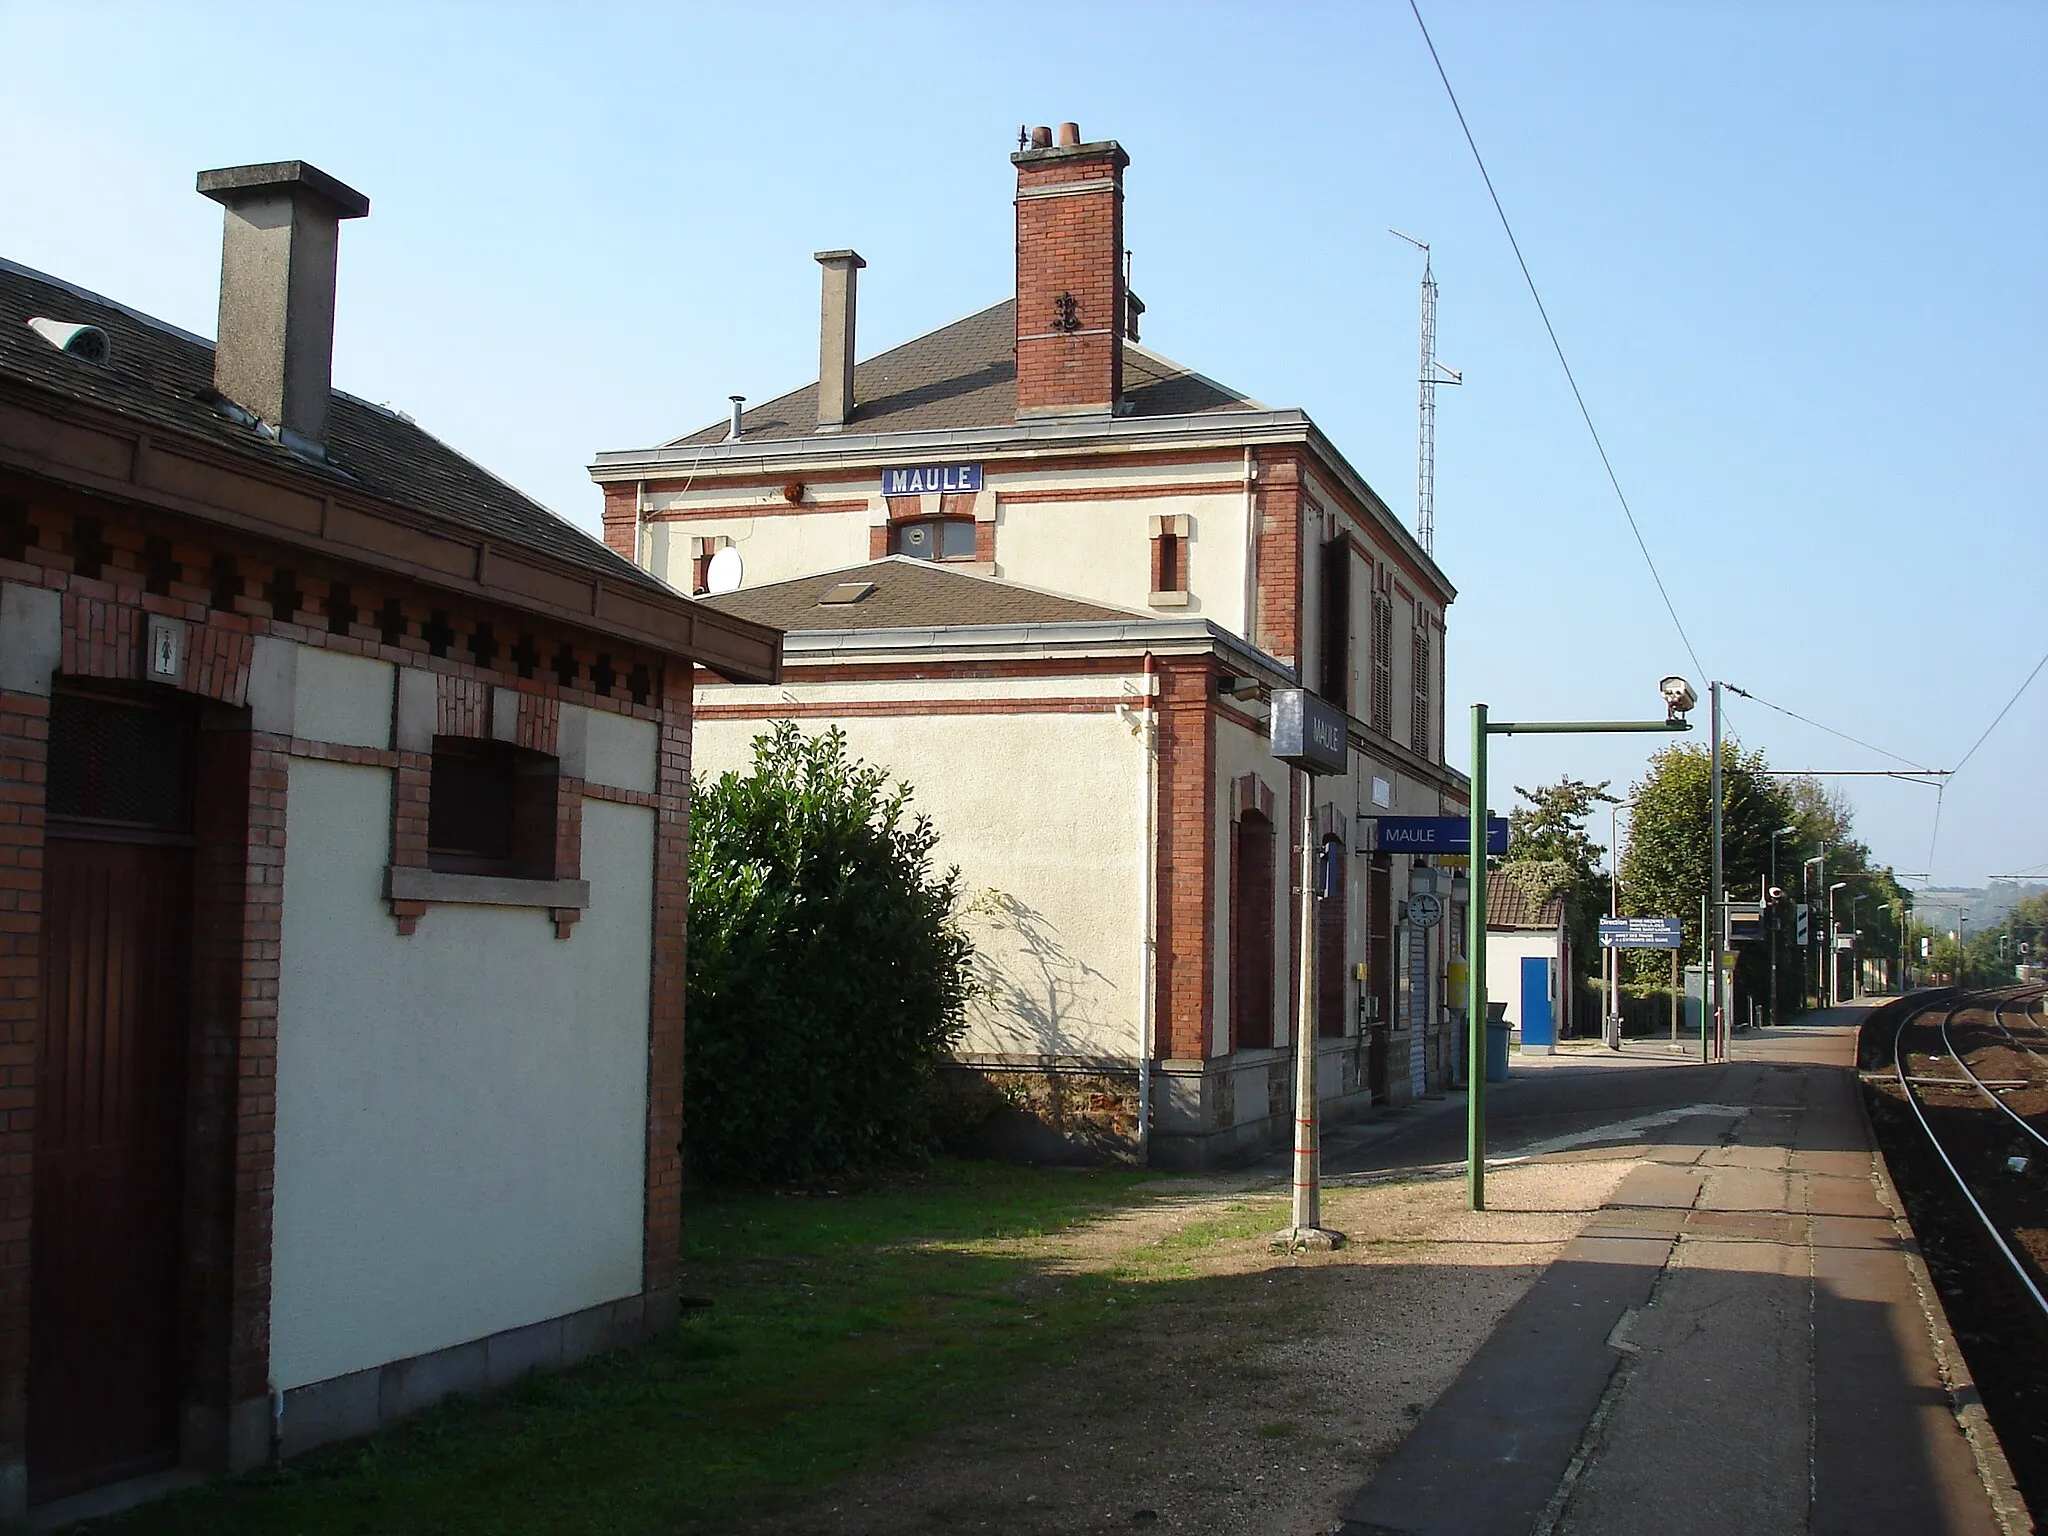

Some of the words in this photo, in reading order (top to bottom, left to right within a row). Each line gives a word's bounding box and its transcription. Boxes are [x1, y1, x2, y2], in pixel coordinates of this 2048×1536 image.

[892, 466, 972, 493] MAULE
[1313, 716, 1338, 752] MAULE
[1385, 829, 1435, 842] MAULE
